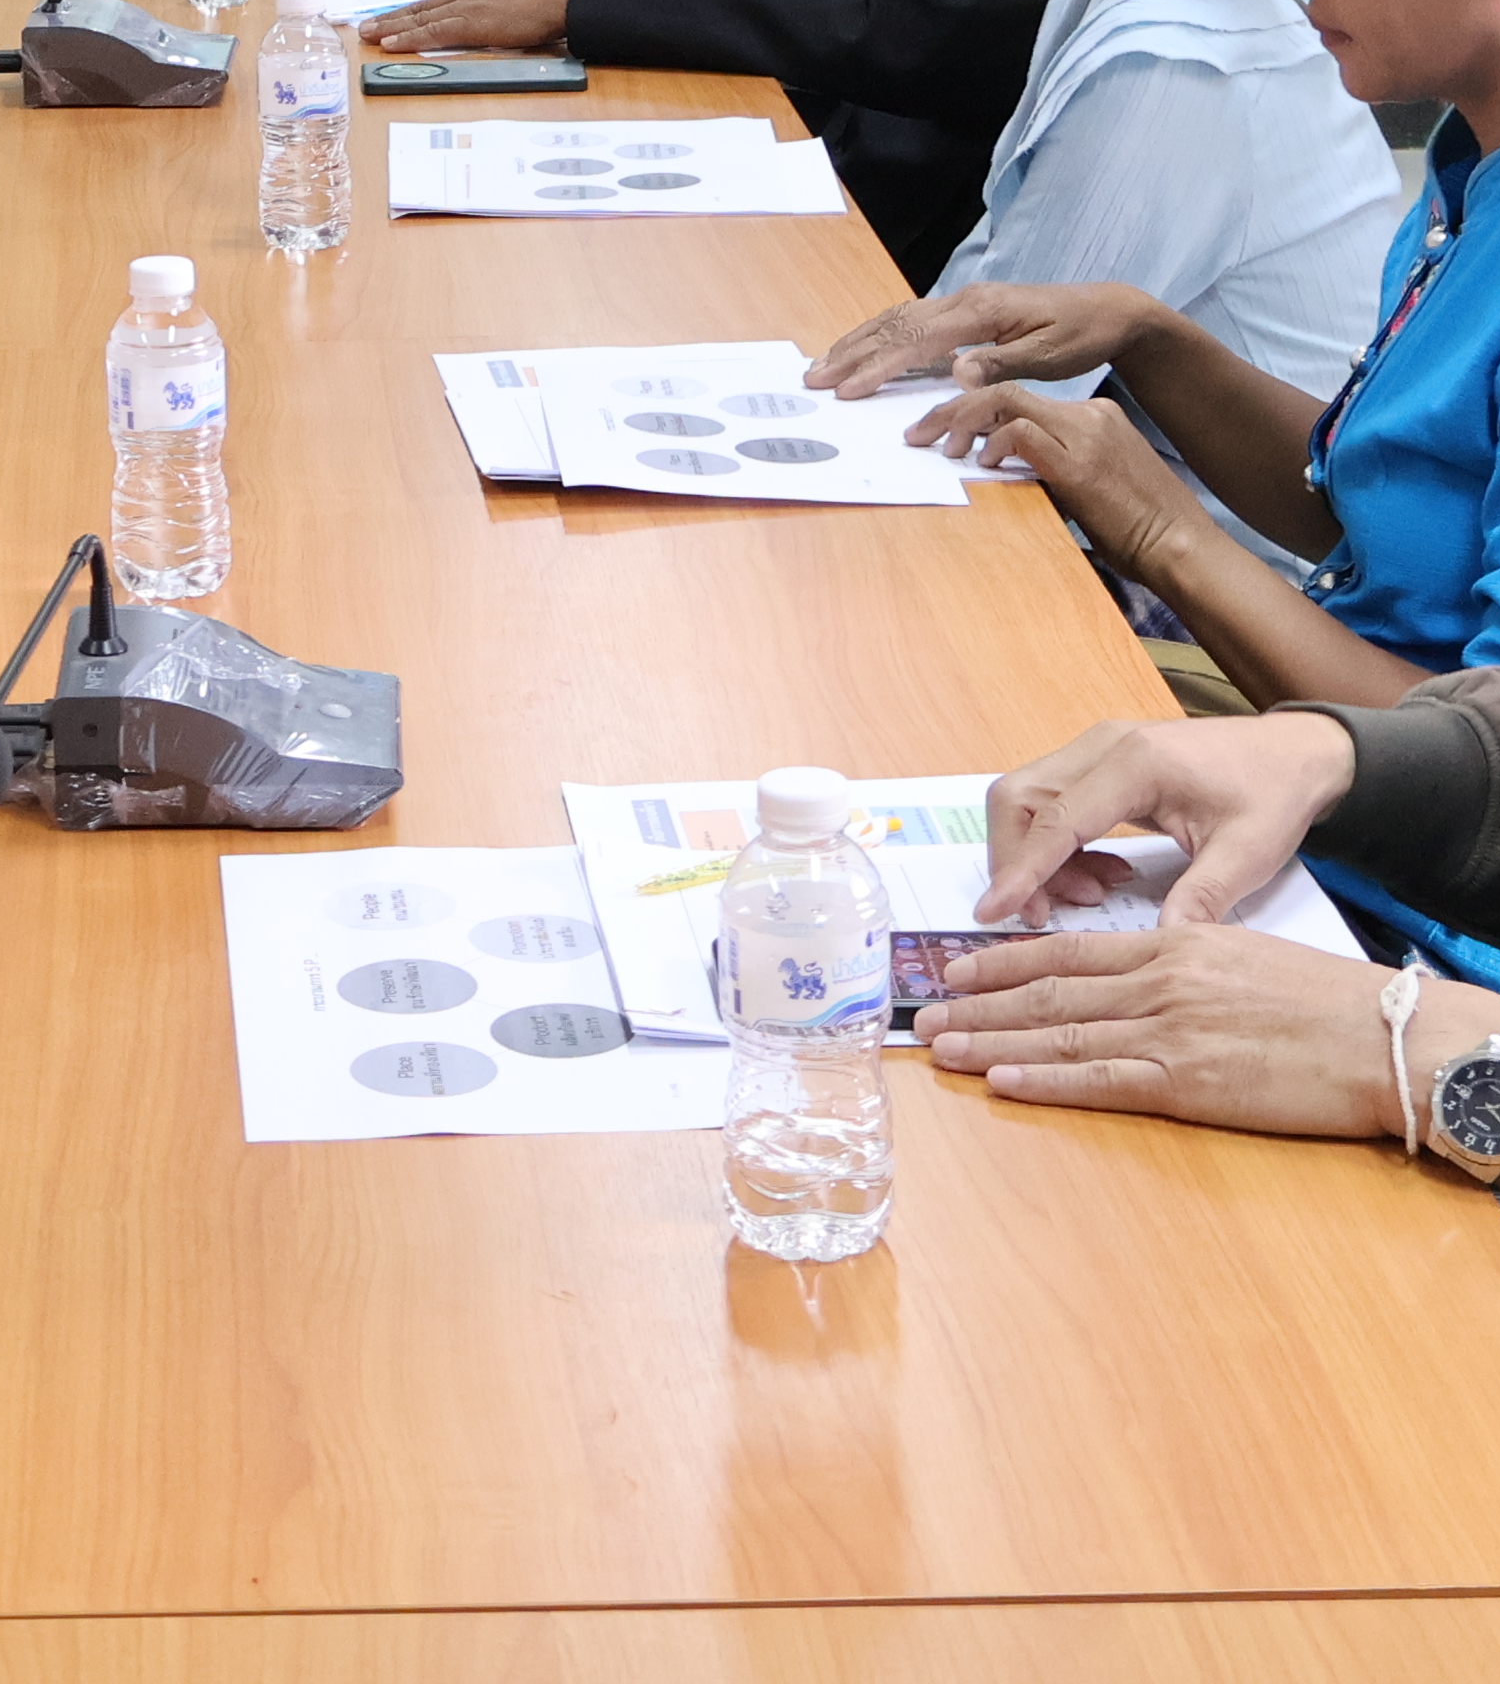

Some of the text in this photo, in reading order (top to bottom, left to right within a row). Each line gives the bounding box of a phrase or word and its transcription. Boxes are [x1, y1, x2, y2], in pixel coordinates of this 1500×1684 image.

[360, 893, 382, 920] People
[380, 969, 398, 1004] Preserve
[530, 1016, 552, 1046] Product
[397, 1056, 415, 1079] Place
